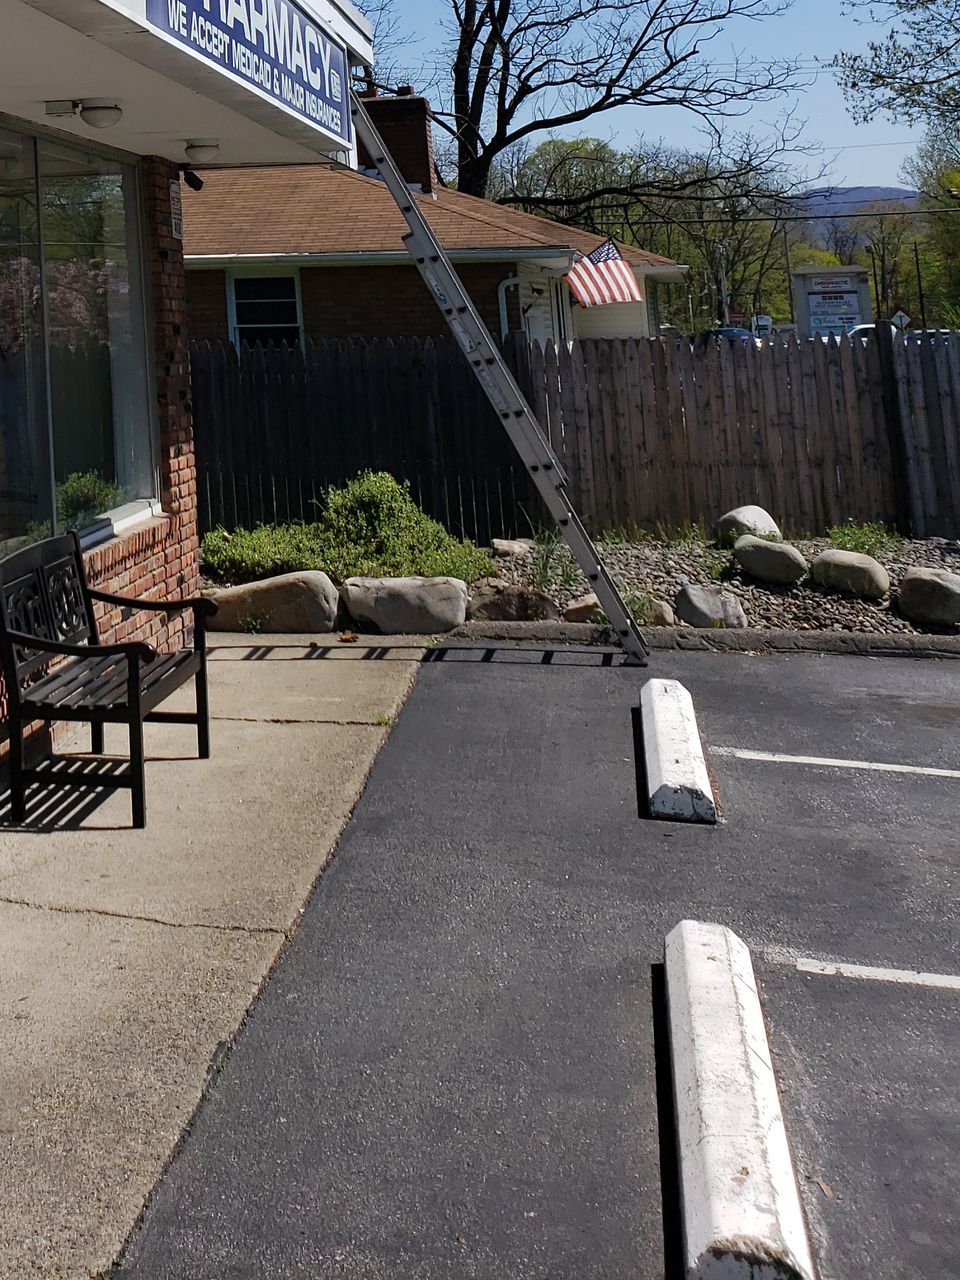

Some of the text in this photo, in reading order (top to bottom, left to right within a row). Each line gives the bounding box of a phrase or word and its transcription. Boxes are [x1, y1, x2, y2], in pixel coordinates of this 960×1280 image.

[191, 11, 230, 64] ACCEPT
[232, 38, 271, 91] MEDICAID
[273, 68, 280, 96] &
[281, 71, 305, 112] MAJOR
[305, 85, 342, 134] INSURANCES
